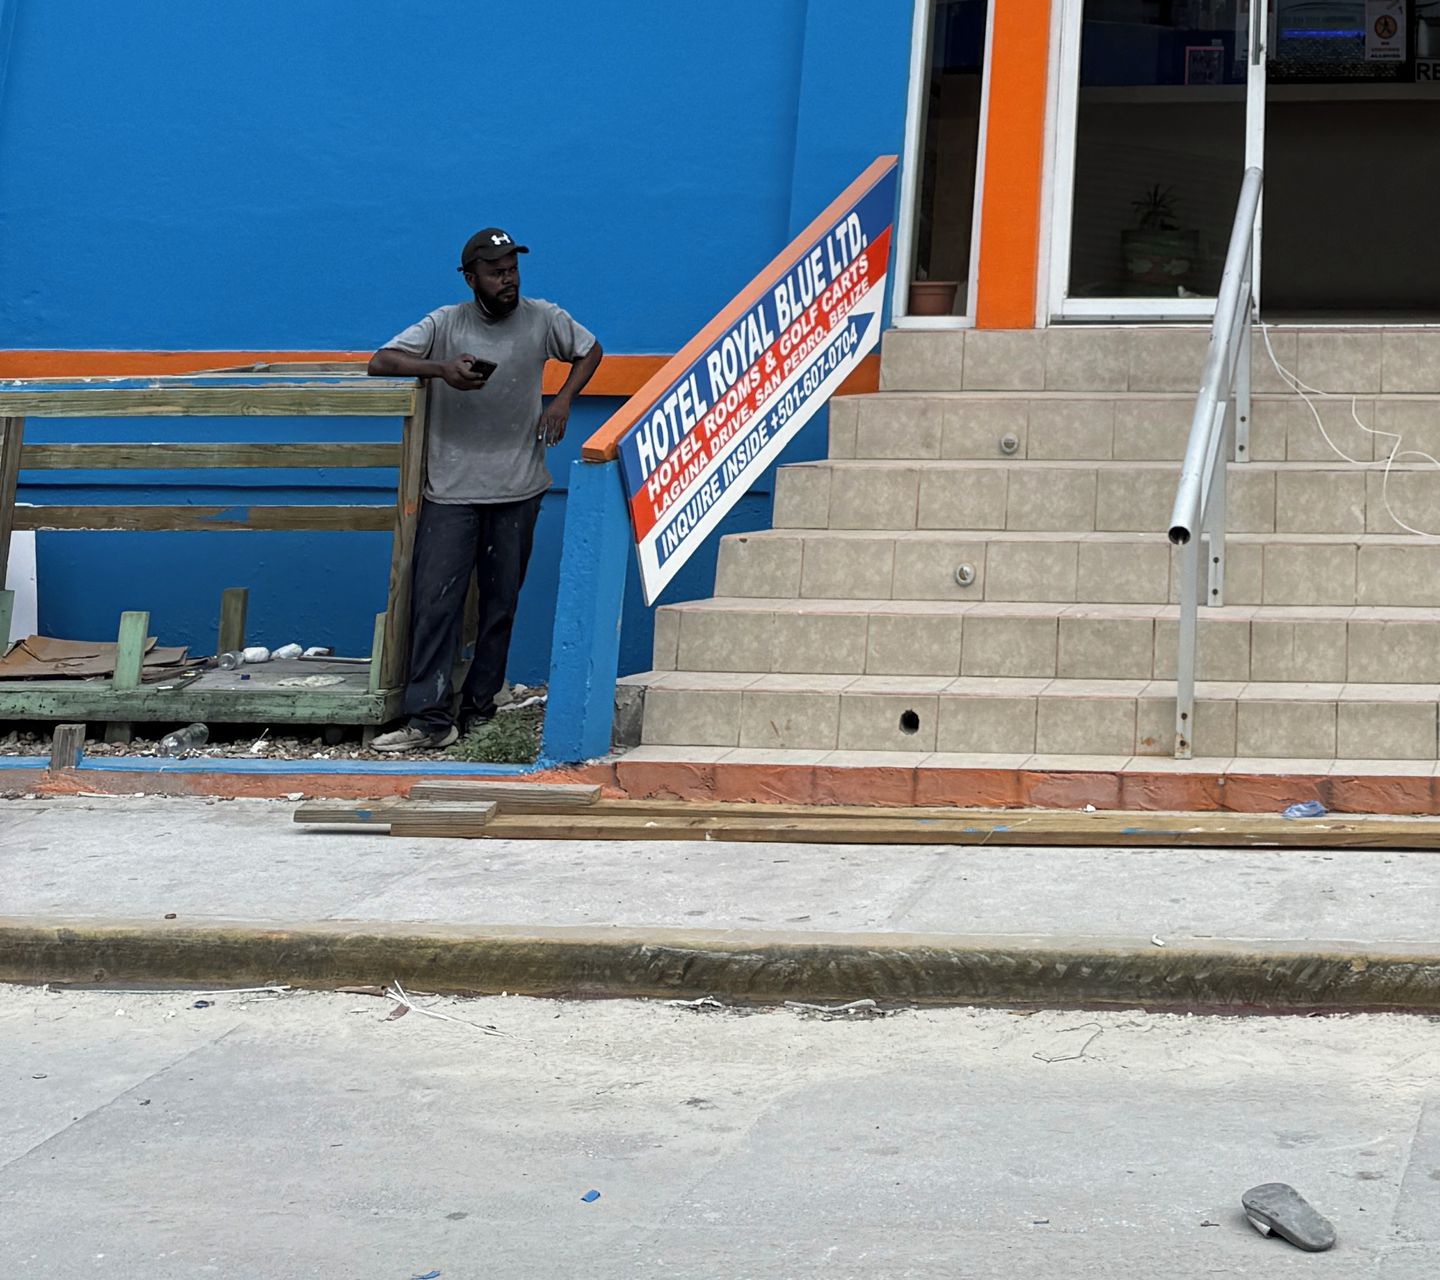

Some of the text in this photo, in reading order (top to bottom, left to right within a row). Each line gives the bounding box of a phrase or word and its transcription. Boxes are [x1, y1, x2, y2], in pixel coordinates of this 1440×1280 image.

[636, 212, 867, 481] HOTEL ROYAL BLUE LTD.
[647, 253, 870, 502] HOTEL ROOMS & GOLF CARTS
[653, 276, 871, 521] LAGUNA DRIVE, SAN PEDRO, BELIZE
[661, 321, 859, 560] INQUIRE INSIDE +501-607-0704
